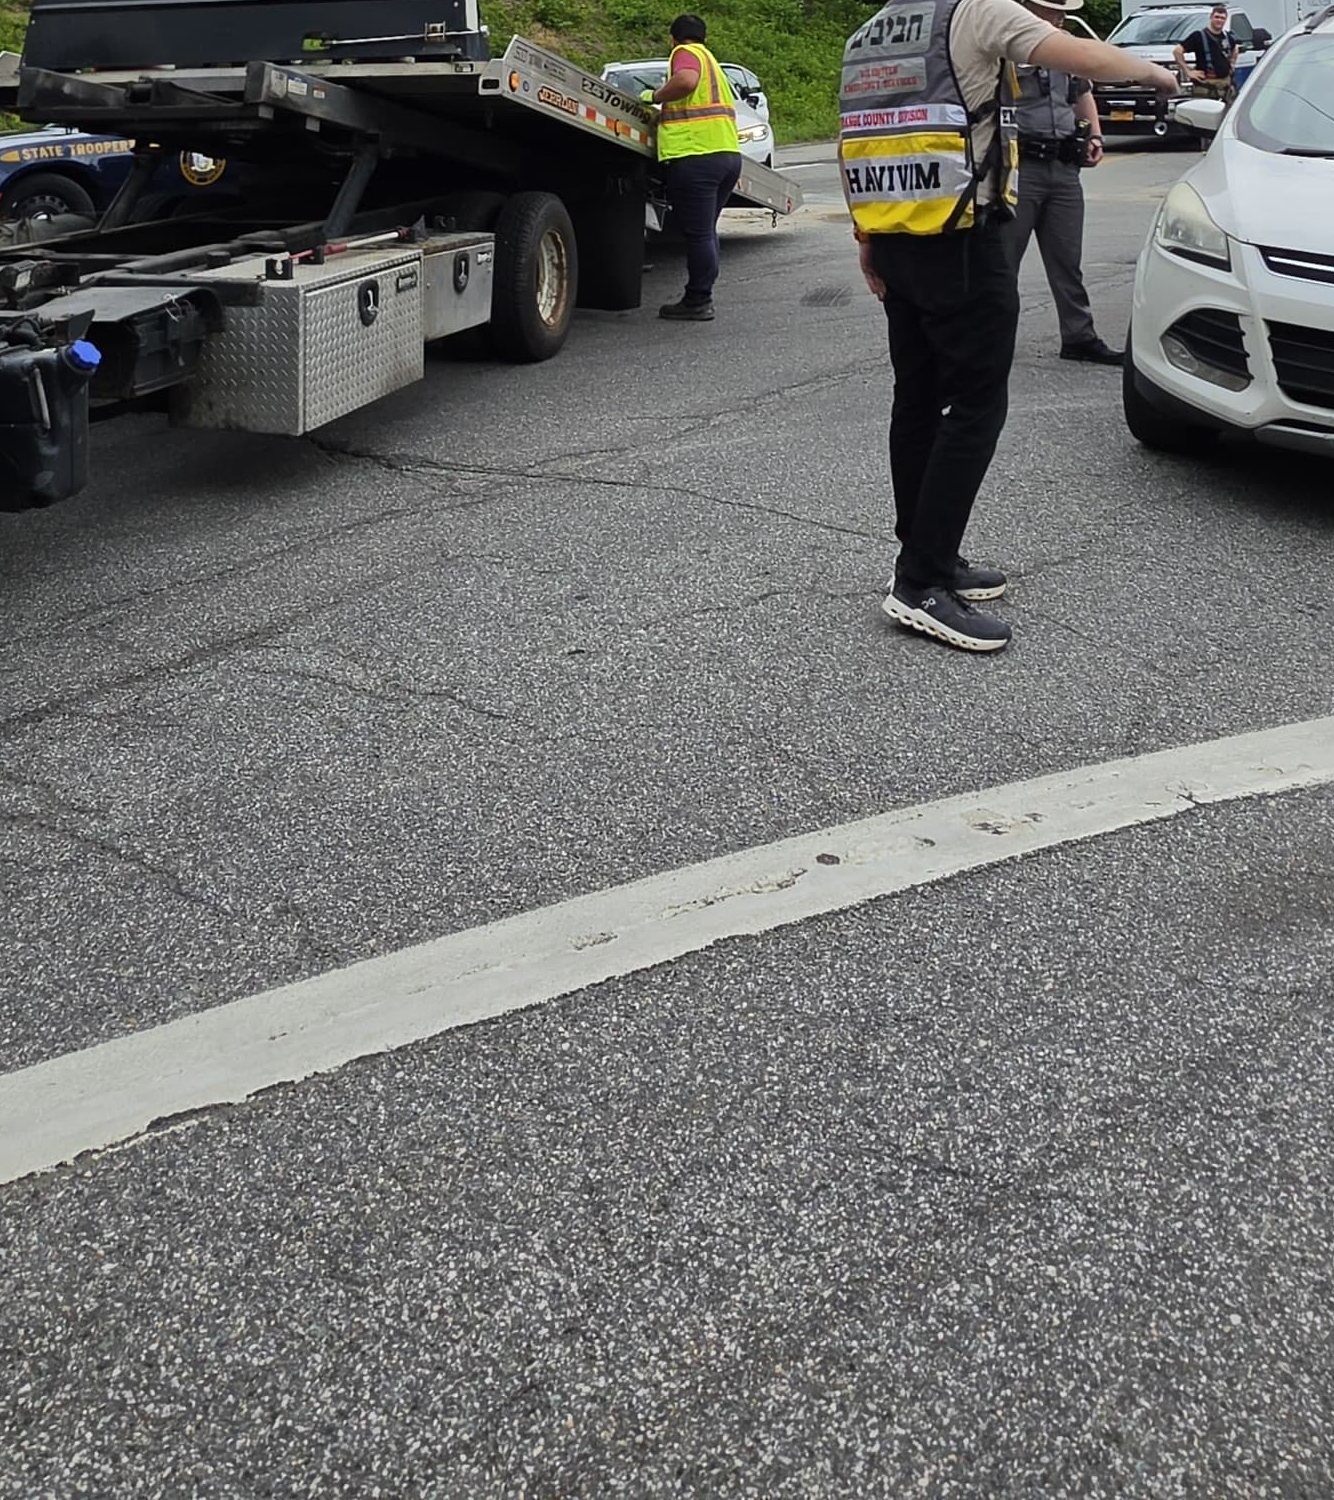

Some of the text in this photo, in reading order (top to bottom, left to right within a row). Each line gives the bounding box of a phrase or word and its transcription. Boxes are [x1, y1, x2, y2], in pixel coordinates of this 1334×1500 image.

[862, 111, 895, 125] COUNTY
[898, 108, 928, 122] DIVISION
[22, 140, 130, 161] STATE TROOPER
[845, 162, 941, 194] HAVIVIM
